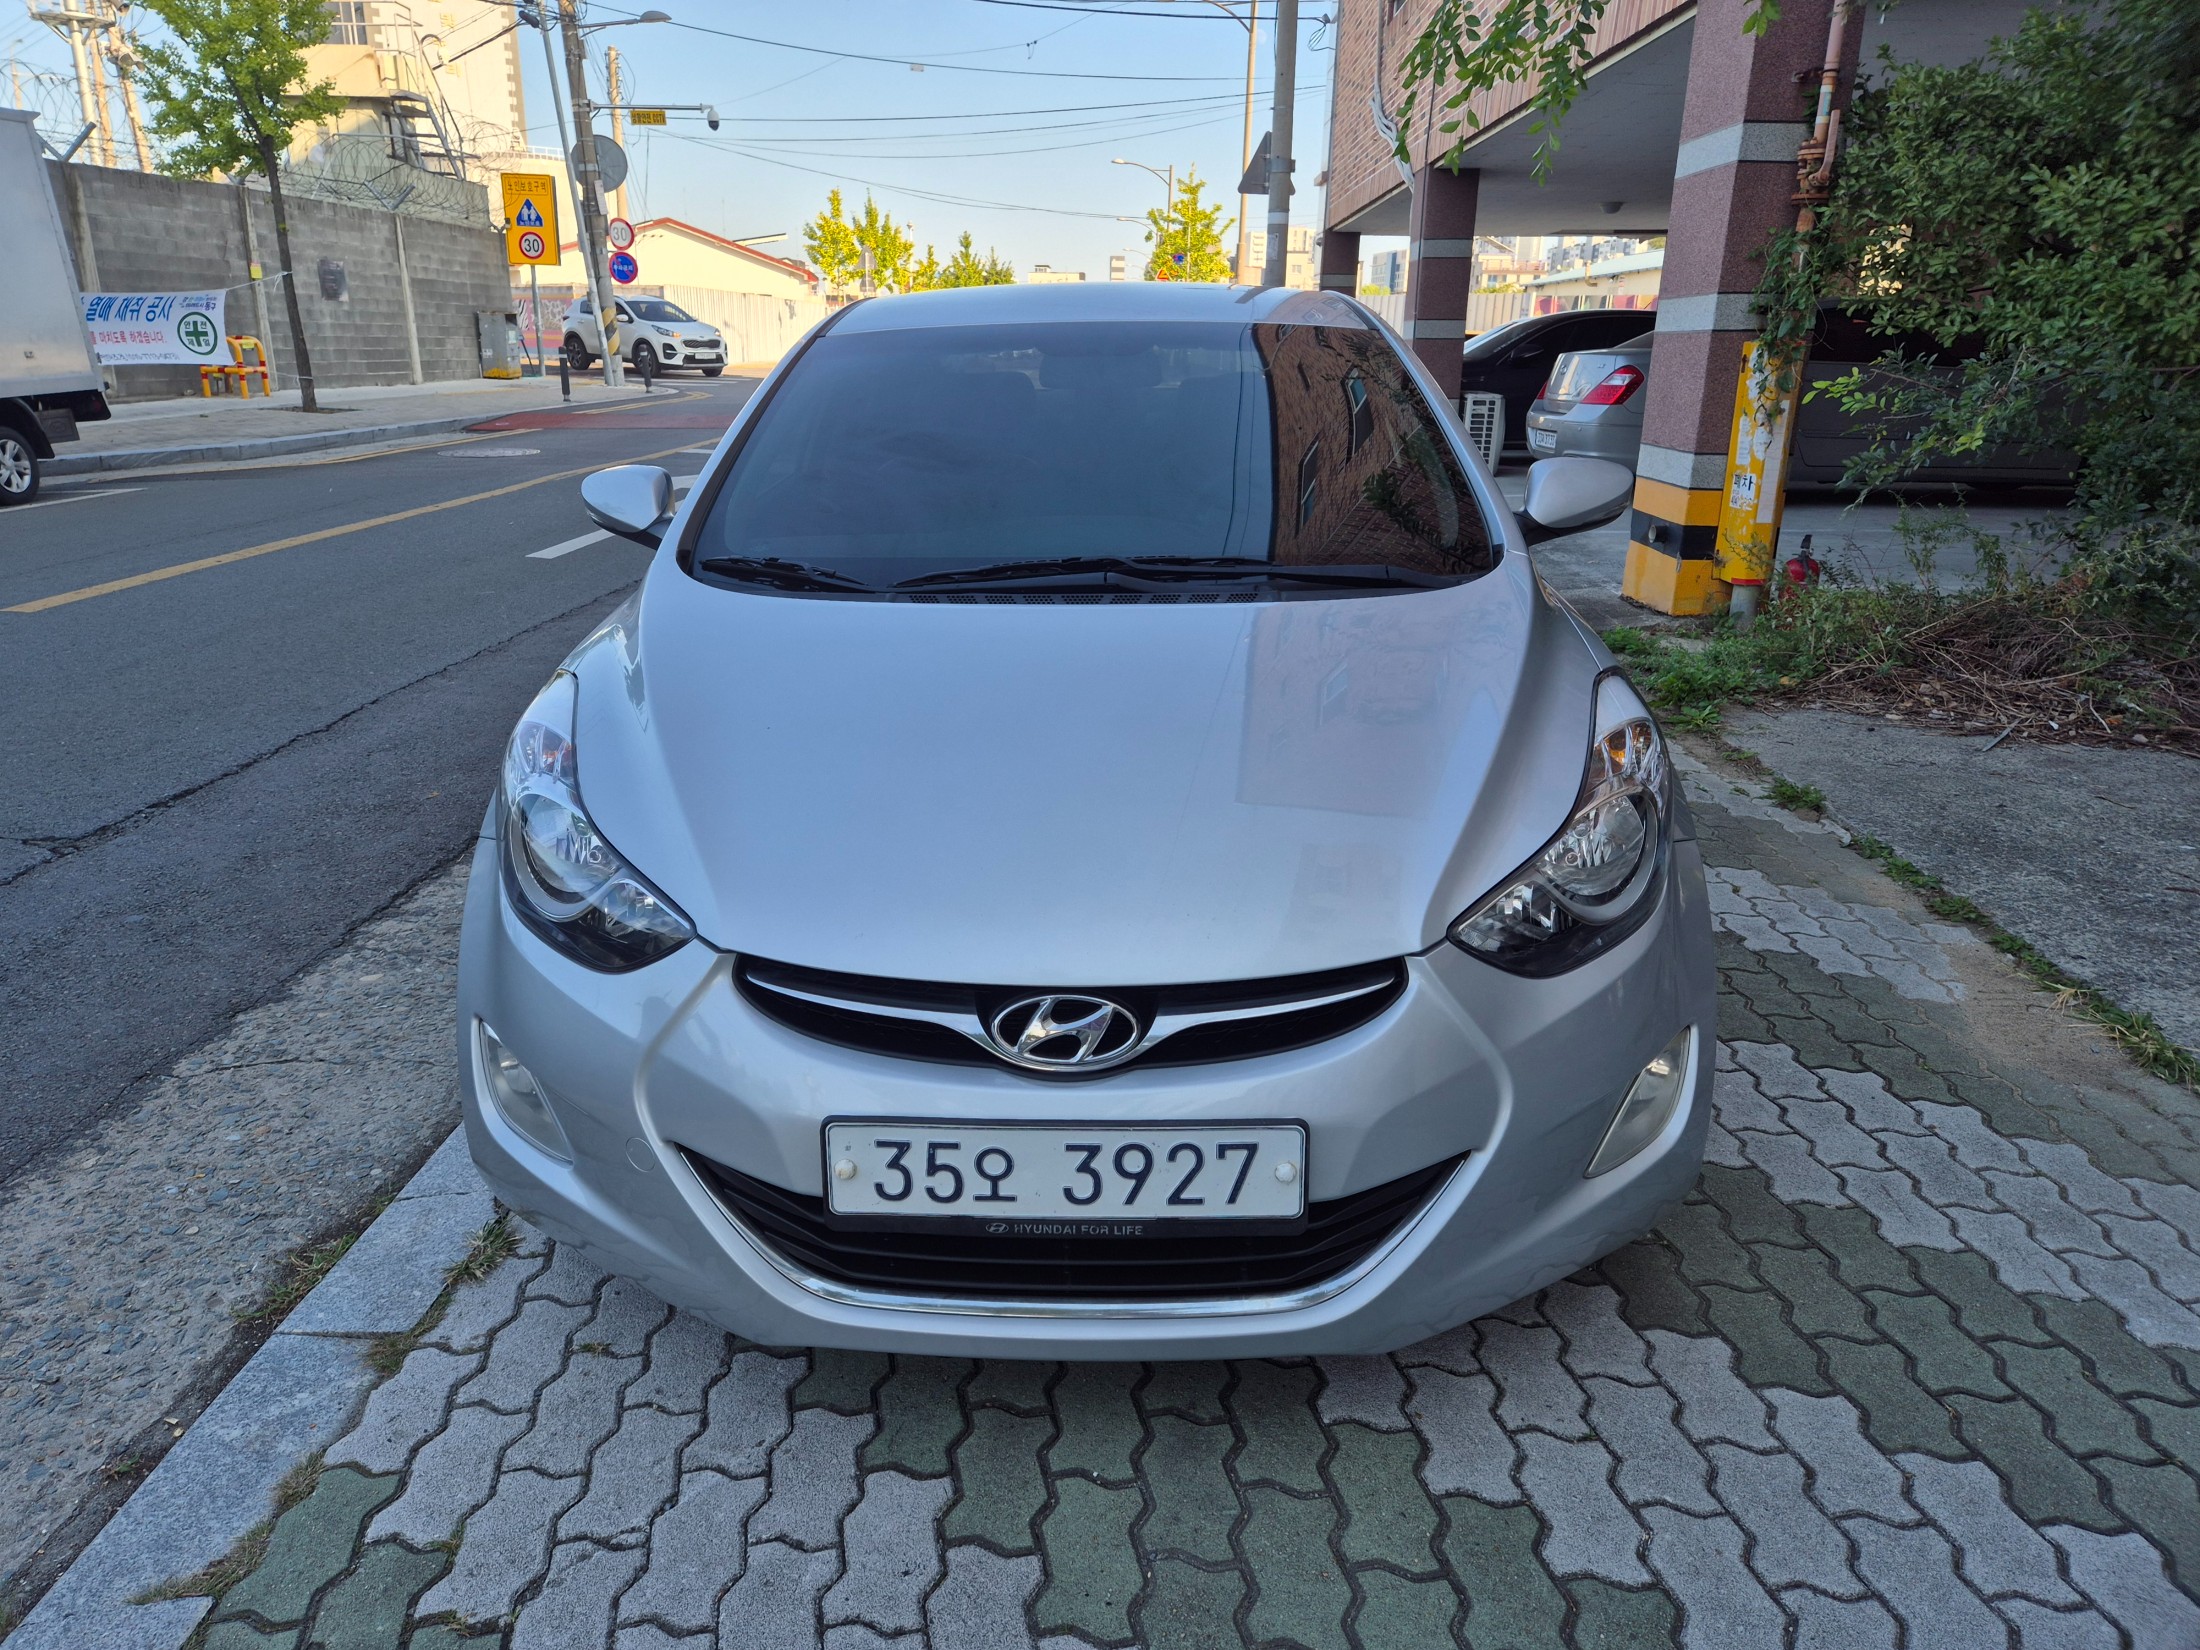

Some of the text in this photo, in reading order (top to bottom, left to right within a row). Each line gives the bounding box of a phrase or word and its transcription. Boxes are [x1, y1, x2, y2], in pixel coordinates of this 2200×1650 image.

[507, 181, 547, 192] 노인보호구역
[613, 226, 628, 242] 30
[523, 238, 540, 253] 30
[86, 296, 176, 322] 열매 채취 공사
[204, 301, 216, 311] 동구
[99, 331, 127, 344] 마치도록
[873, 1139, 1260, 1206] 35오 3927
[1014, 1224, 1143, 1236] HYUNDAI FOR LIFE
